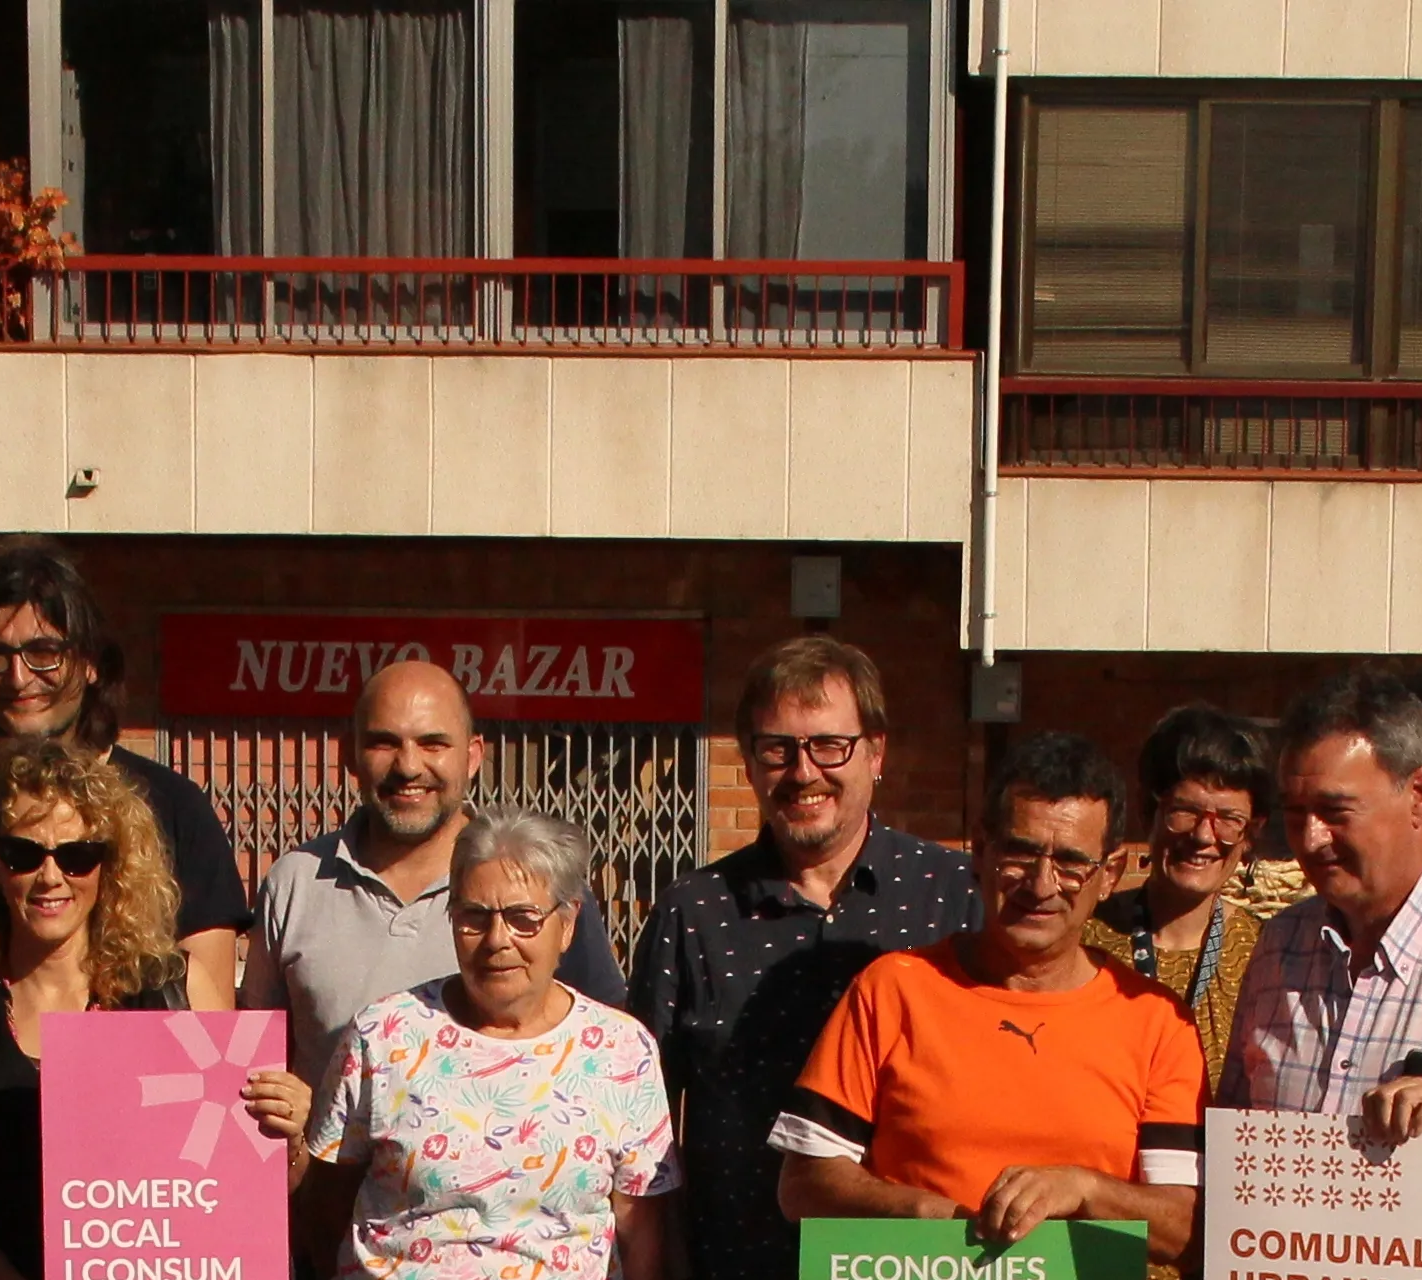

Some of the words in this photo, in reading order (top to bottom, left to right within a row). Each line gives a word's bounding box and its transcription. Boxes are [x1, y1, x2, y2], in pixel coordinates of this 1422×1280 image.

[452, 644, 636, 697] BAZAR
[61, 1178, 219, 1214] COMERÇ
[63, 1219, 181, 1249] LOCAL
